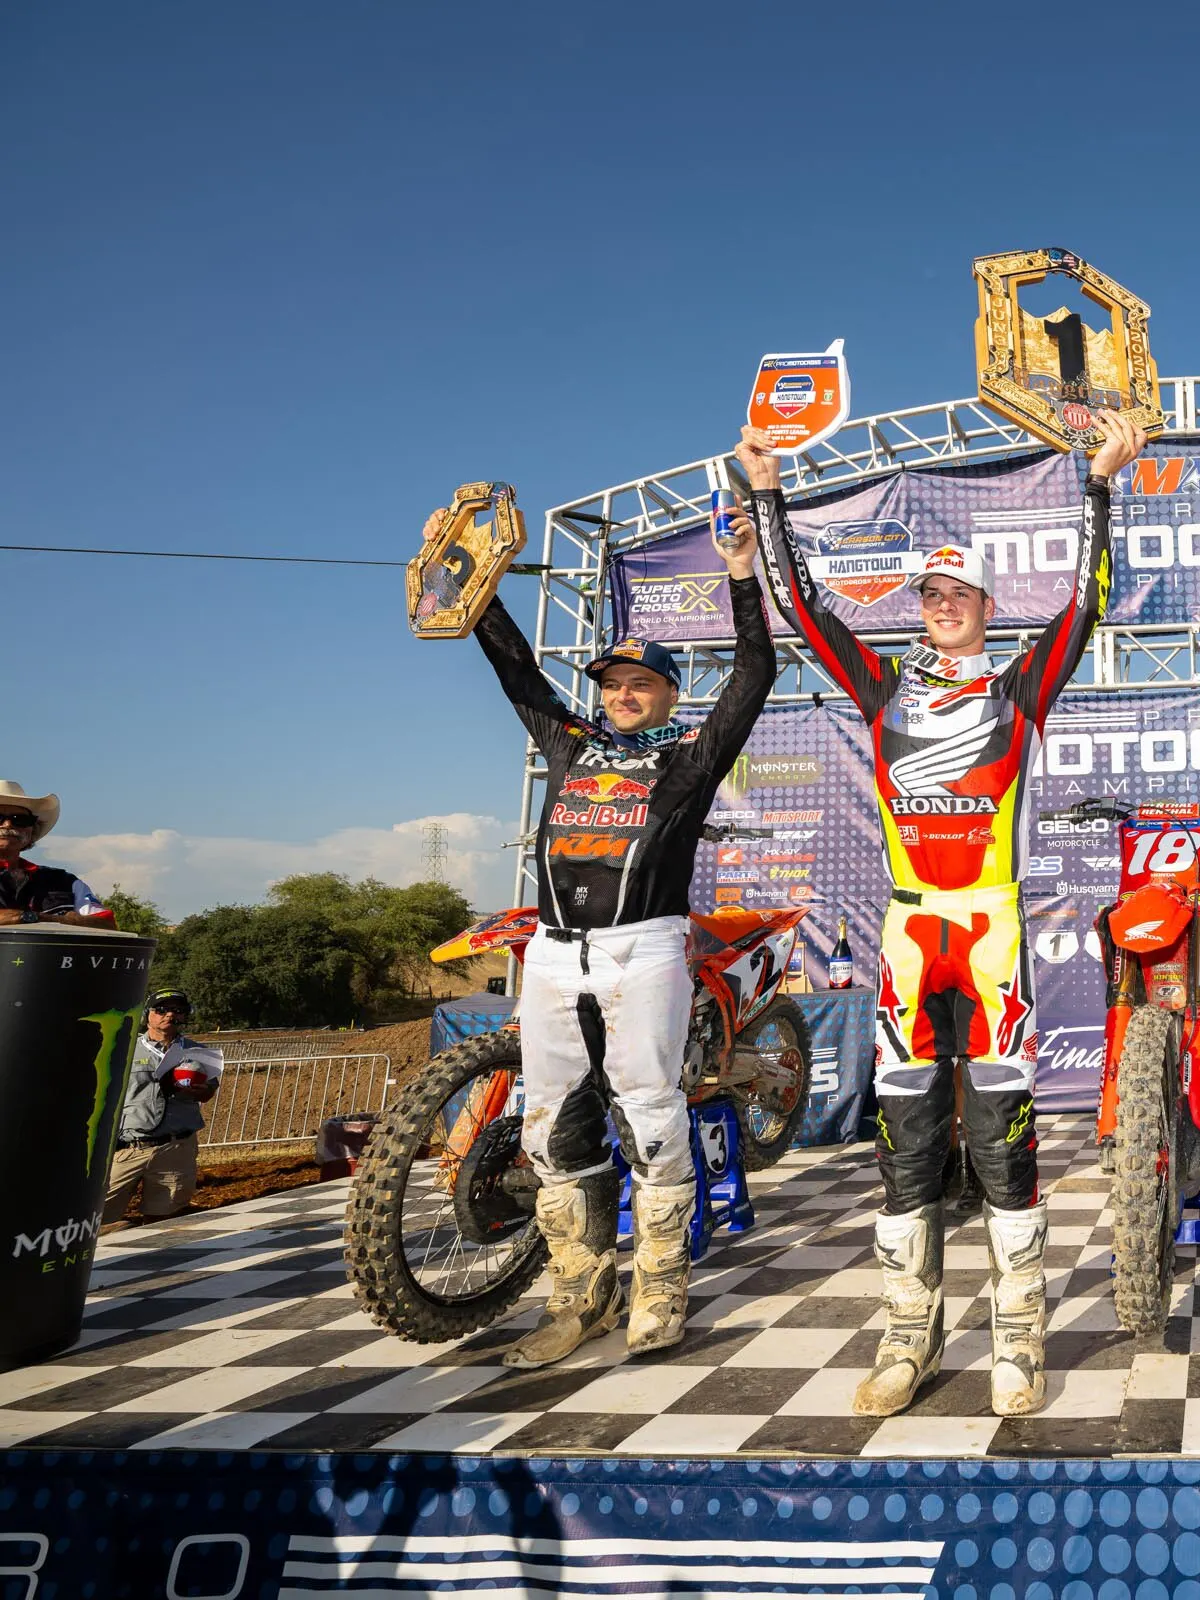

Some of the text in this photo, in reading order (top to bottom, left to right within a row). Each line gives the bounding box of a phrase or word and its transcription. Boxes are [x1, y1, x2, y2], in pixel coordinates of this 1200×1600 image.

[1044, 313, 1088, 403] 1
[885, 533, 906, 541] CITY
[828, 556, 902, 574] HANGTOWN
[926, 558, 965, 571] Red Bull
[874, 576, 904, 584] CLASSIC
[631, 585, 684, 594] SUPER
[635, 594, 681, 603] MOTO
[631, 603, 683, 613] CROSS
[633, 613, 725, 625] WORLD CHAMPIONSHIP
[890, 796, 998, 815] HONDA
[549, 803, 649, 828] Red Bull
[713, 810, 755, 820] GEICO
[1038, 819, 1110, 835] GEICO
[549, 833, 631, 857] KTM
[1047, 838, 1101, 848] MOTORCYCLE
[779, 869, 811, 878] THOR
[576, 886, 589, 894] MX
[1123, 933, 1165, 943] HONDA
[61, 956, 73, 969] B
[749, 944, 783, 998] 2
[1036, 1025, 1103, 1070] Fina
[709, 1124, 726, 1172] 3
[42, 1250, 89, 1273] ENE
